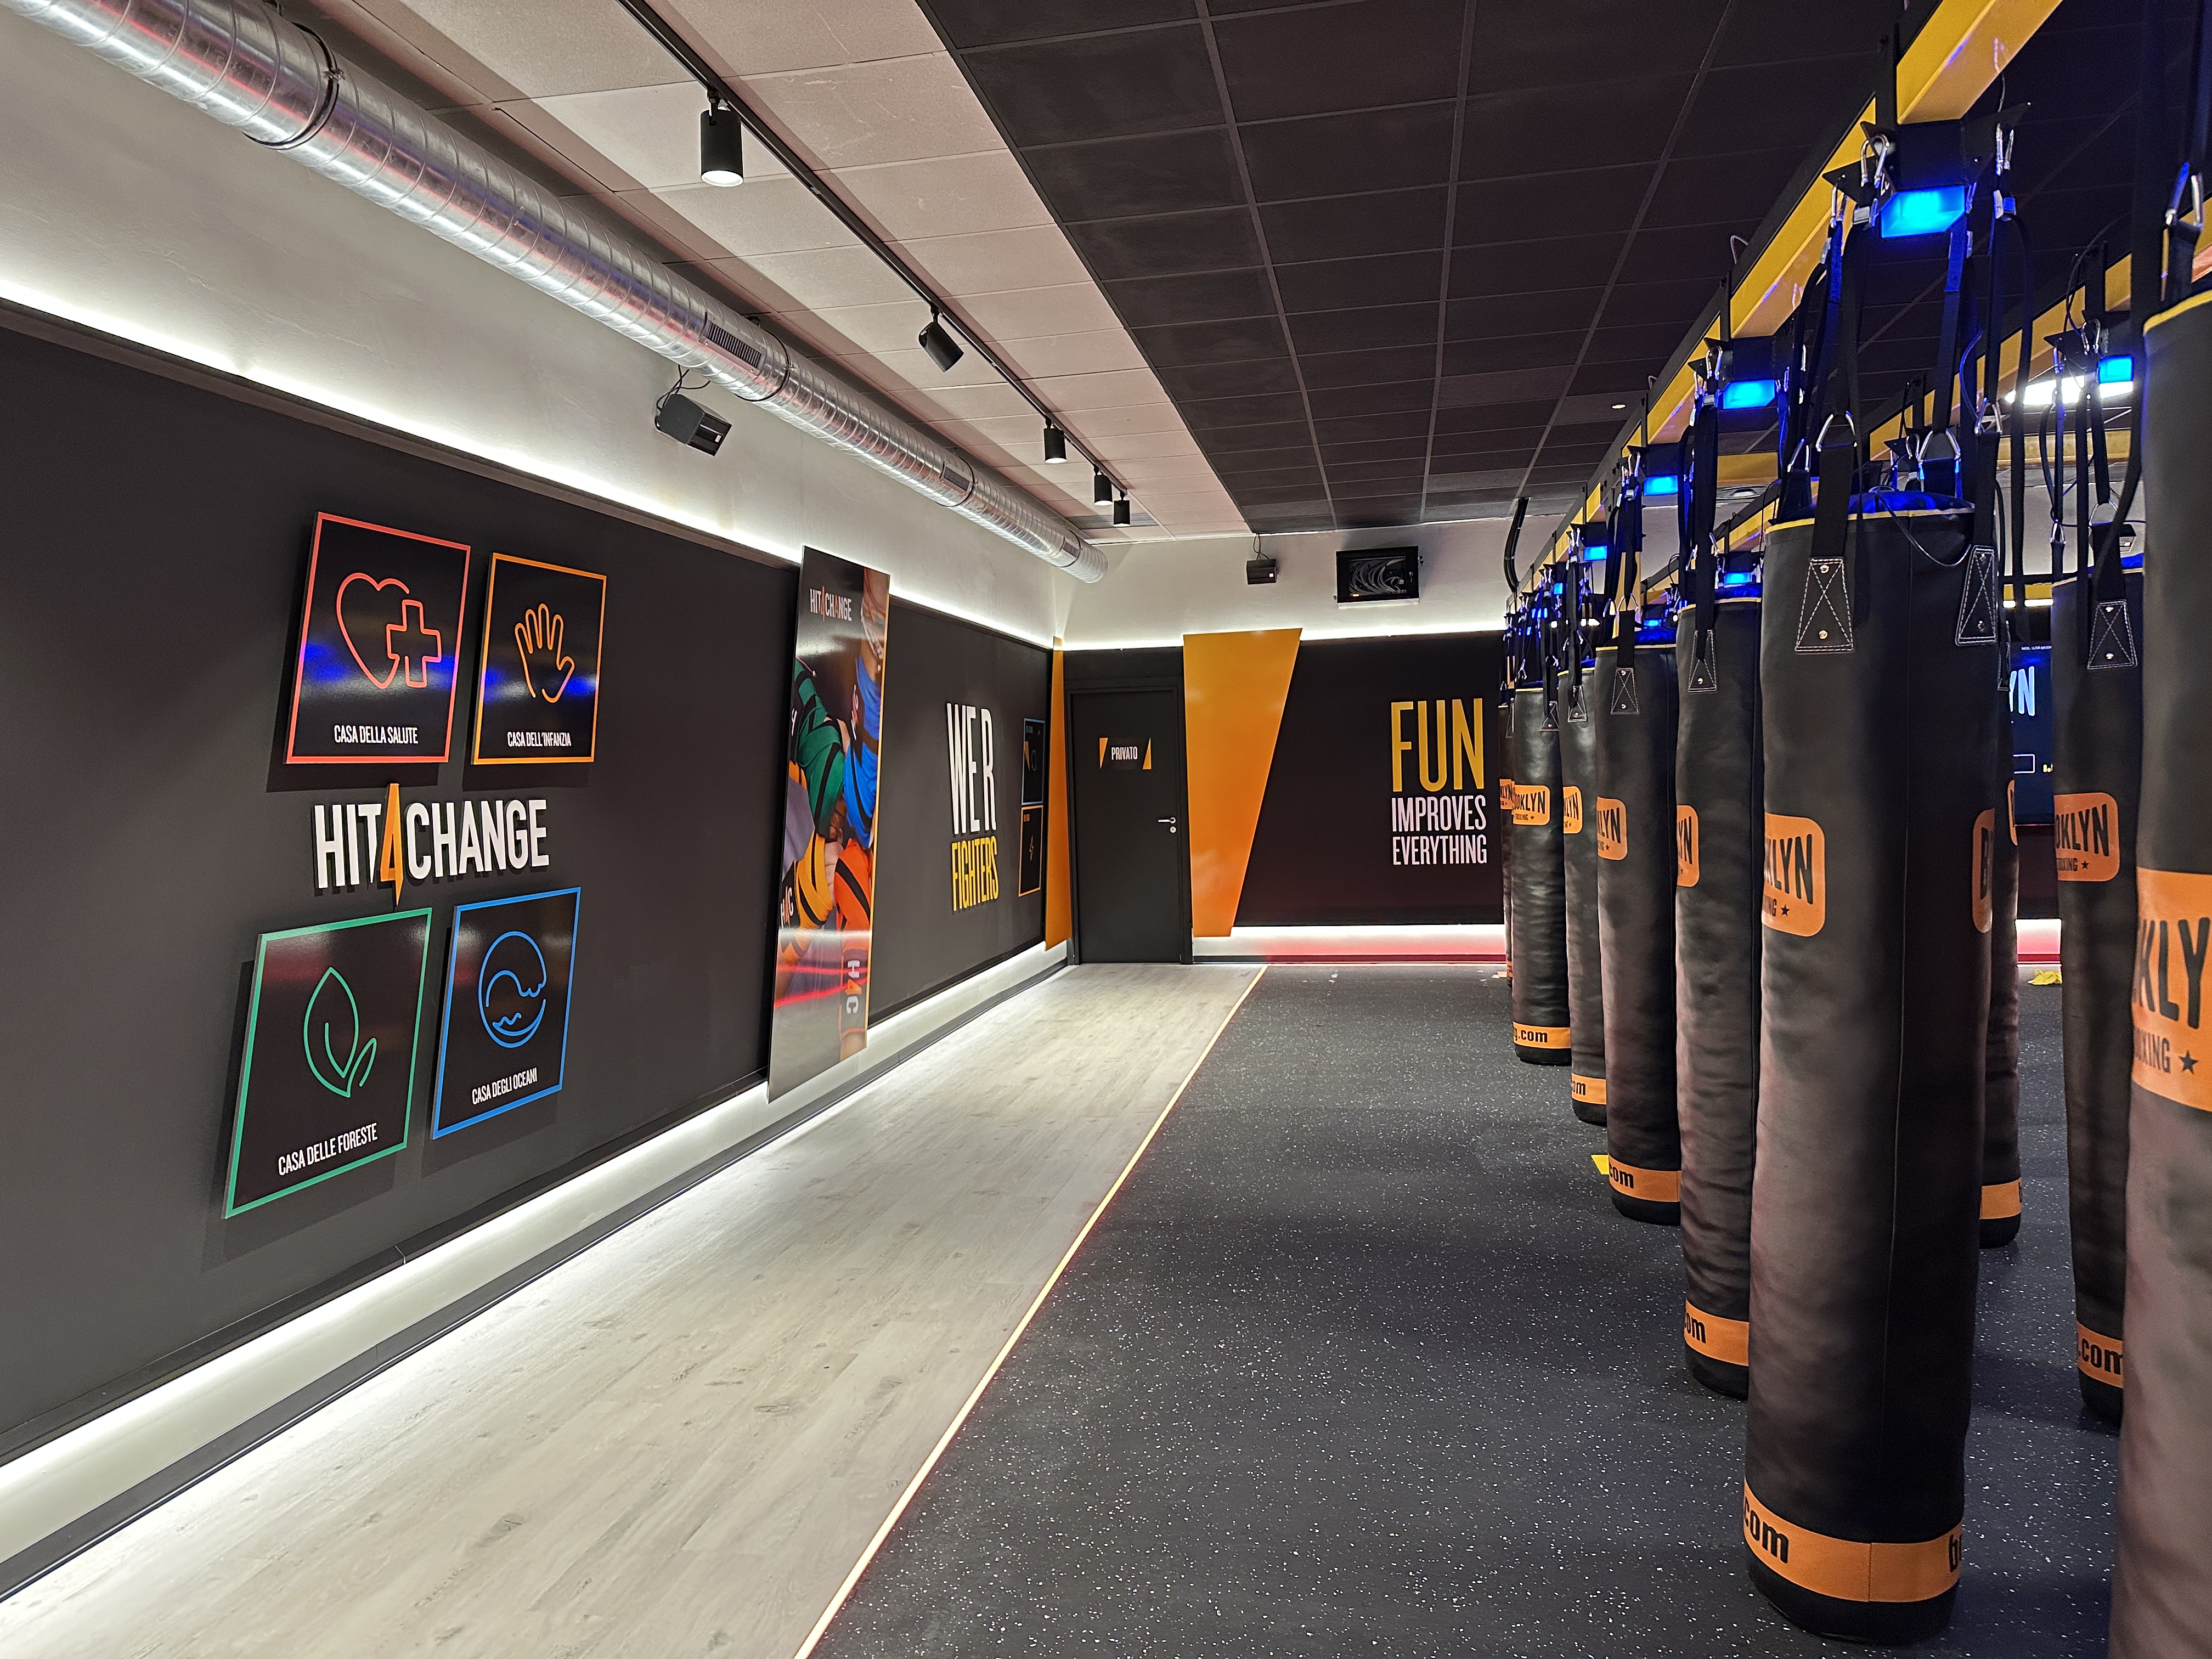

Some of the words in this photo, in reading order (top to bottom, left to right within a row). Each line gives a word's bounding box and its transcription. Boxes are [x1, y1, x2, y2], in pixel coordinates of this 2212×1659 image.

[334, 725, 359, 743] CASA
[359, 725, 386, 744] DELLA
[387, 726, 419, 744] SALUTE
[507, 731, 526, 747] CASA
[526, 732, 572, 747] DELL'INFANZIA
[1111, 746, 1138, 760] PRIVATO
[1391, 698, 1485, 792] FUN
[947, 703, 980, 834] WE
[981, 708, 997, 831] R
[1391, 794, 1486, 832] IMPROVES
[314, 783, 549, 906] HIT4CHANGE
[1392, 834, 1487, 865] EVERYTHING
[952, 836, 999, 912] FIGHTERS
[472, 1084, 491, 1105] CASA
[492, 1076, 512, 1098] DEGLI
[513, 1067, 537, 1090] OCEANI
[278, 1150, 306, 1176] CASA
[307, 1138, 337, 1165] DELLE
[337, 1122, 378, 1154] FORESTE
[1685, 1312, 1706, 1344] om
